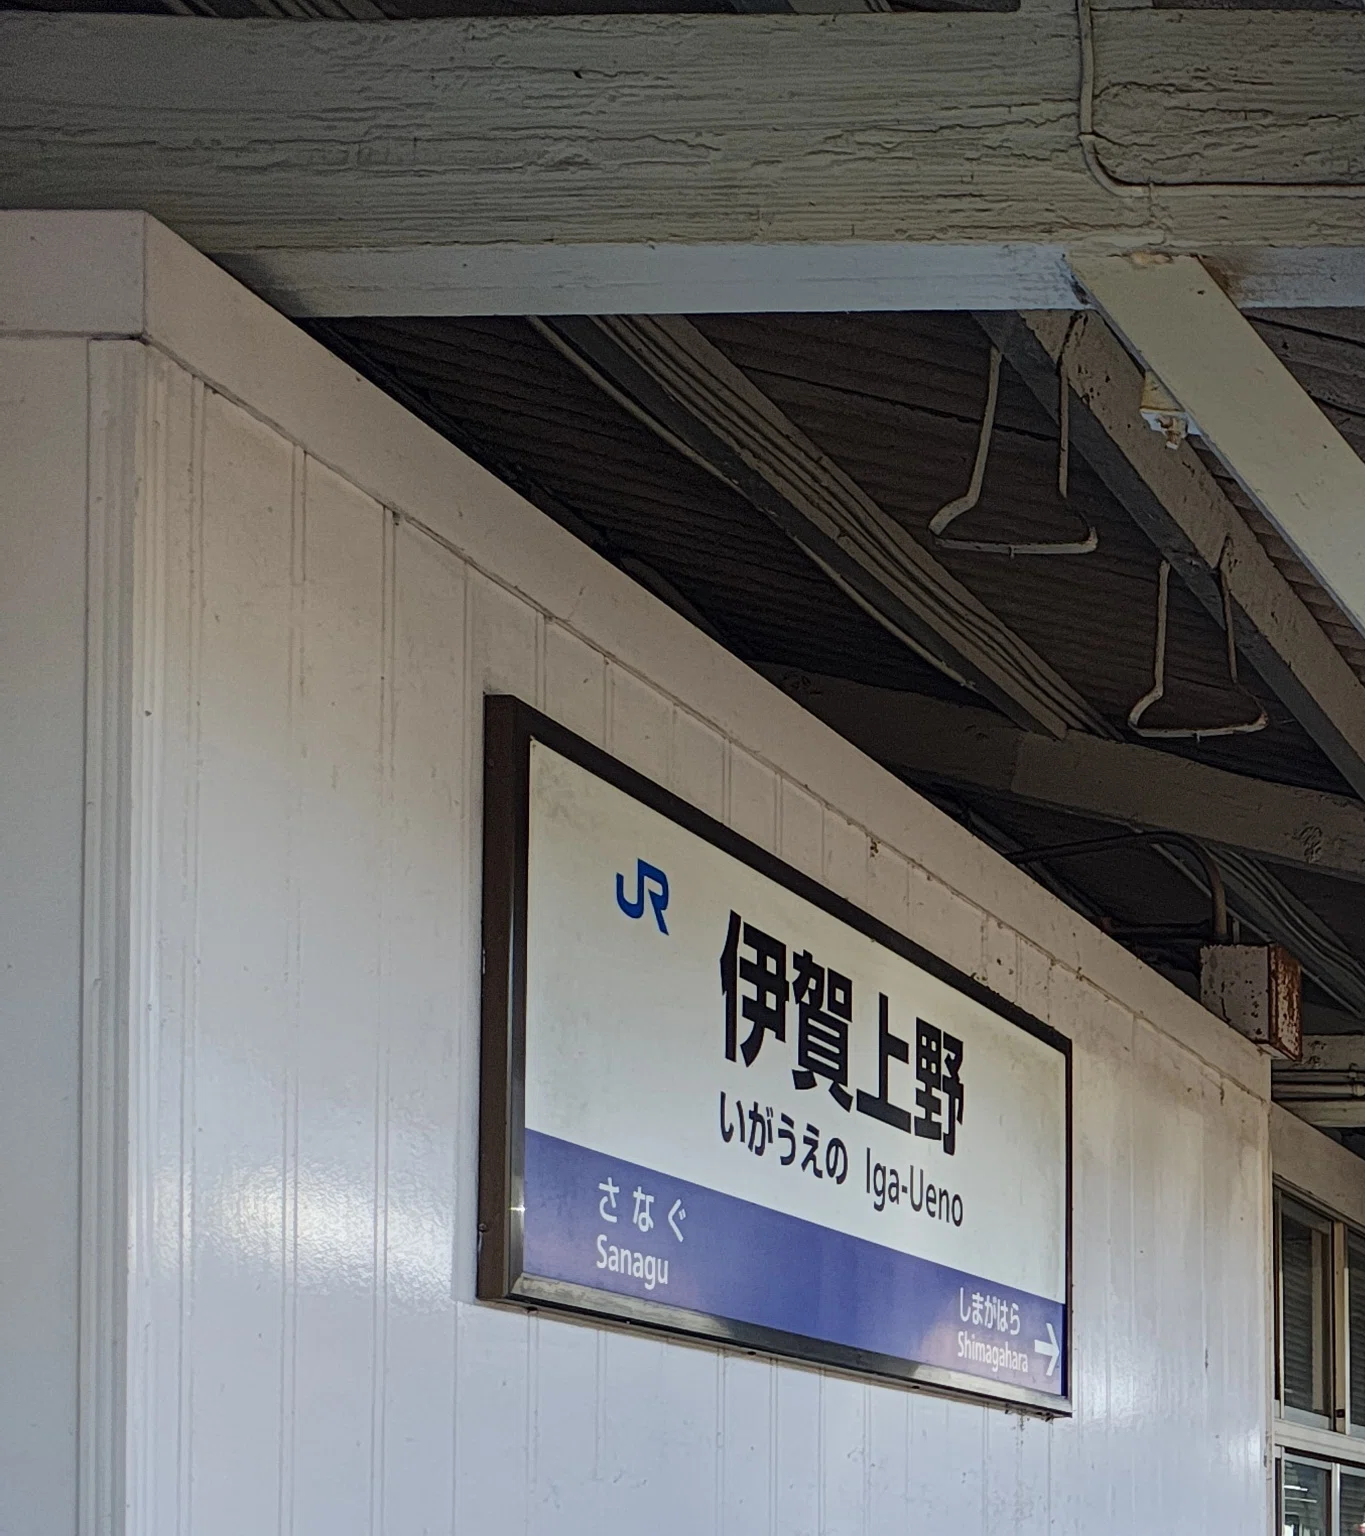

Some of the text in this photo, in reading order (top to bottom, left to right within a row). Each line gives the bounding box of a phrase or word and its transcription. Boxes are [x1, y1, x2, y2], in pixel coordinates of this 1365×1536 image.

[616, 858, 670, 936] JR
[720, 910, 966, 1157] 伊賀上野
[719, 1089, 849, 1187] いがうえの
[866, 1146, 965, 1227] Iga-Ueno
[596, 1235, 670, 1289] Sanagu
[959, 1287, 1022, 1337] しまがはら
[957, 1329, 1031, 1375] Shimagahara
